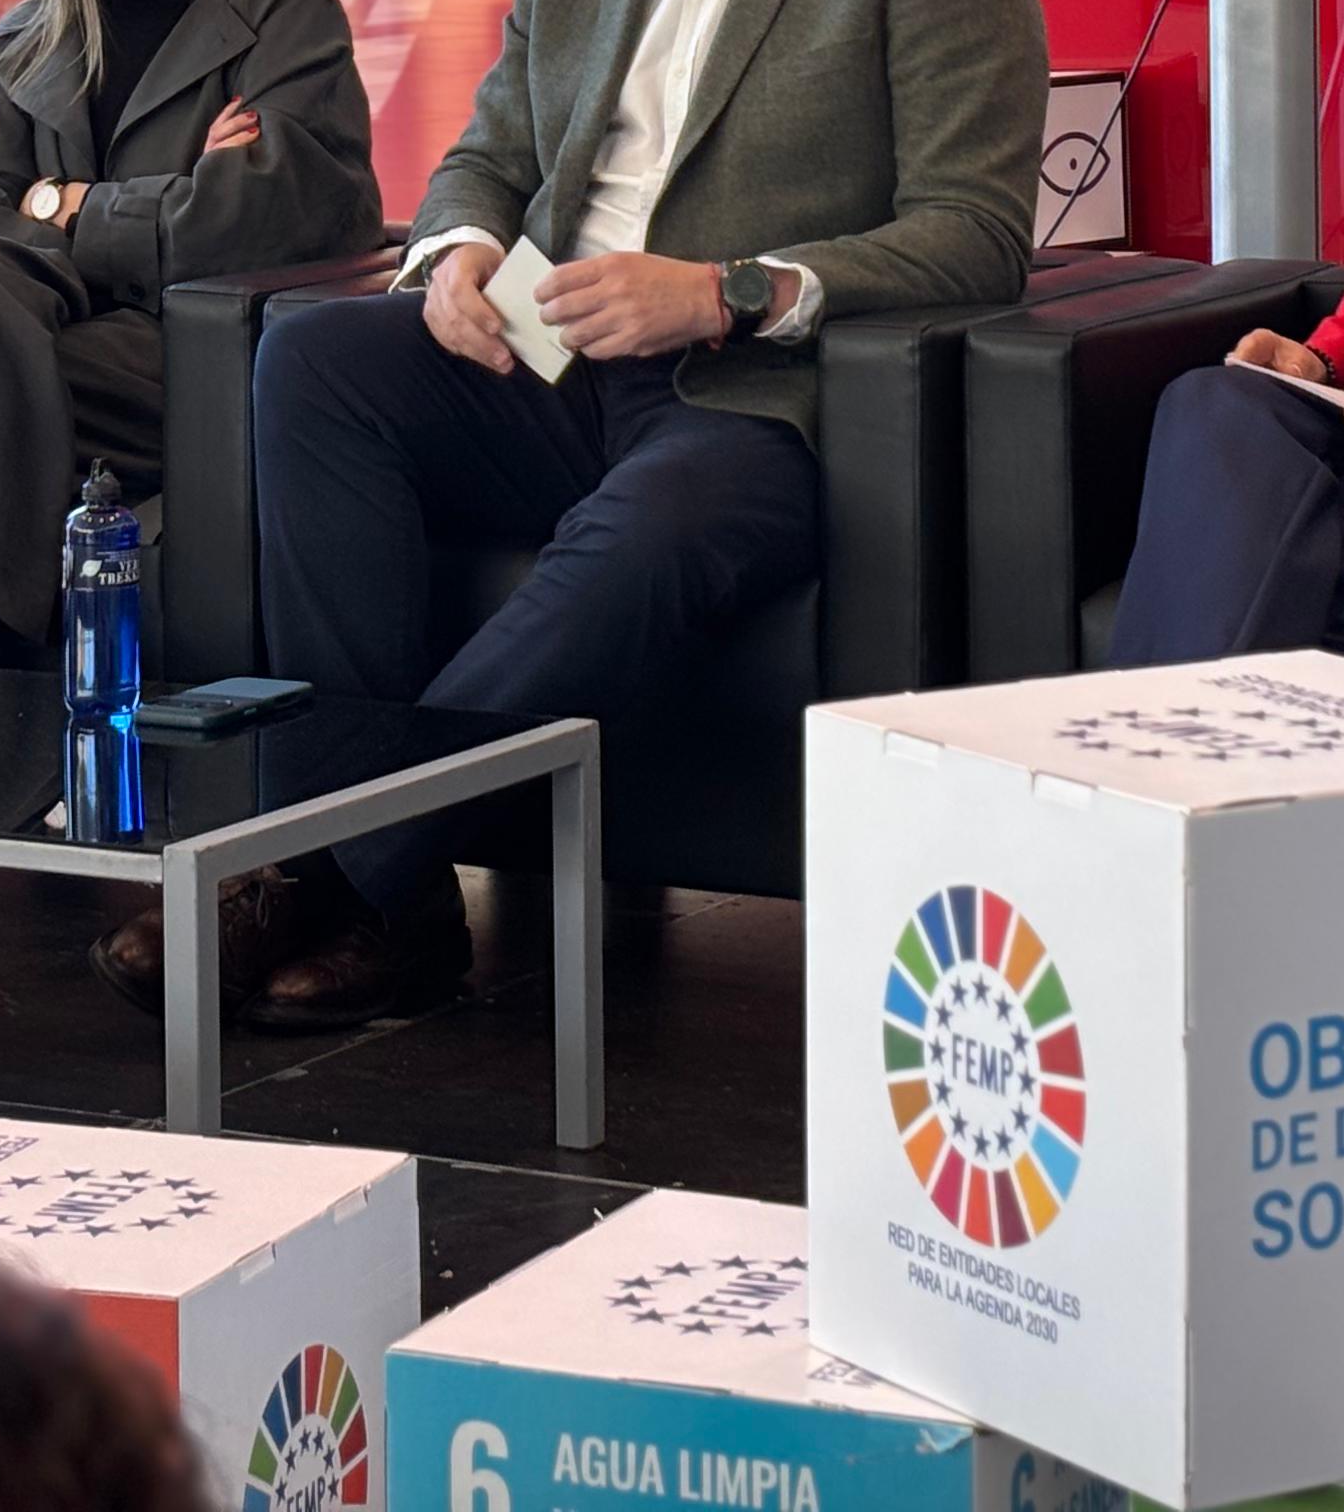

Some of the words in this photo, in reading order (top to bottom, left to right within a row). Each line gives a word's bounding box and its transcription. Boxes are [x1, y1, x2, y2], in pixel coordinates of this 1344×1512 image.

[951, 1032, 1015, 1097] FEMP
[1251, 1111, 1318, 1172] DE
[35, 1181, 147, 1224] FEMP
[683, 1271, 802, 1320] FEMP
[887, 1221, 915, 1253] RED
[918, 1236, 937, 1261] DE
[939, 1242, 1014, 1296] ENTIDADES
[1017, 1276, 1081, 1321] LOCALES
[908, 1262, 943, 1295] PARA
[945, 1282, 963, 1306] LA
[966, 1286, 1023, 1332] AGENDA
[1026, 1309, 1058, 1345] 2030
[450, 1420, 512, 1512] 6
[553, 1432, 666, 1497] AGUA
[679, 1448, 821, 1512] LIMPIA
